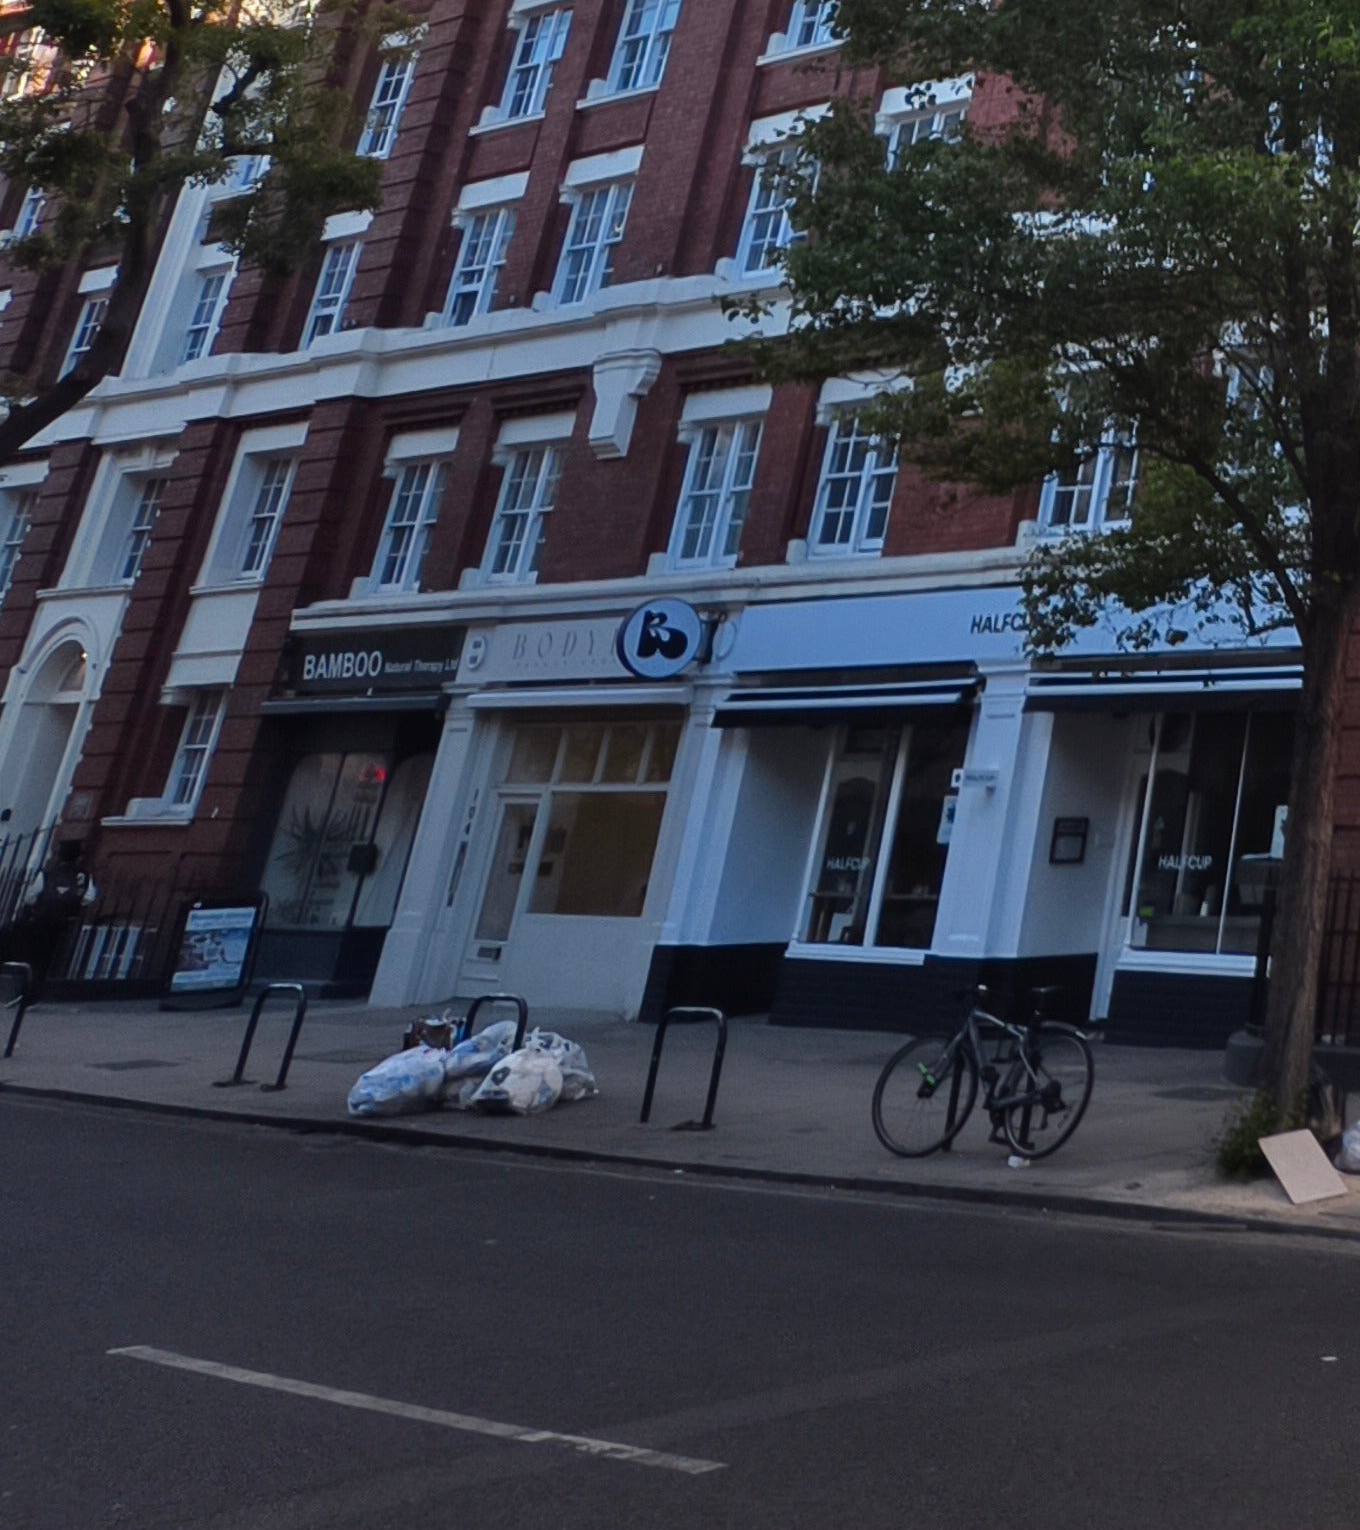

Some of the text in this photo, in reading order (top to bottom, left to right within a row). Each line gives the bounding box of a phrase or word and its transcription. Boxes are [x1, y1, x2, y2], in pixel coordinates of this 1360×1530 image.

[970, 612, 1030, 634] HALFC
[303, 650, 382, 680] BAMBOO
[1158, 854, 1212, 870] HALFCUP
